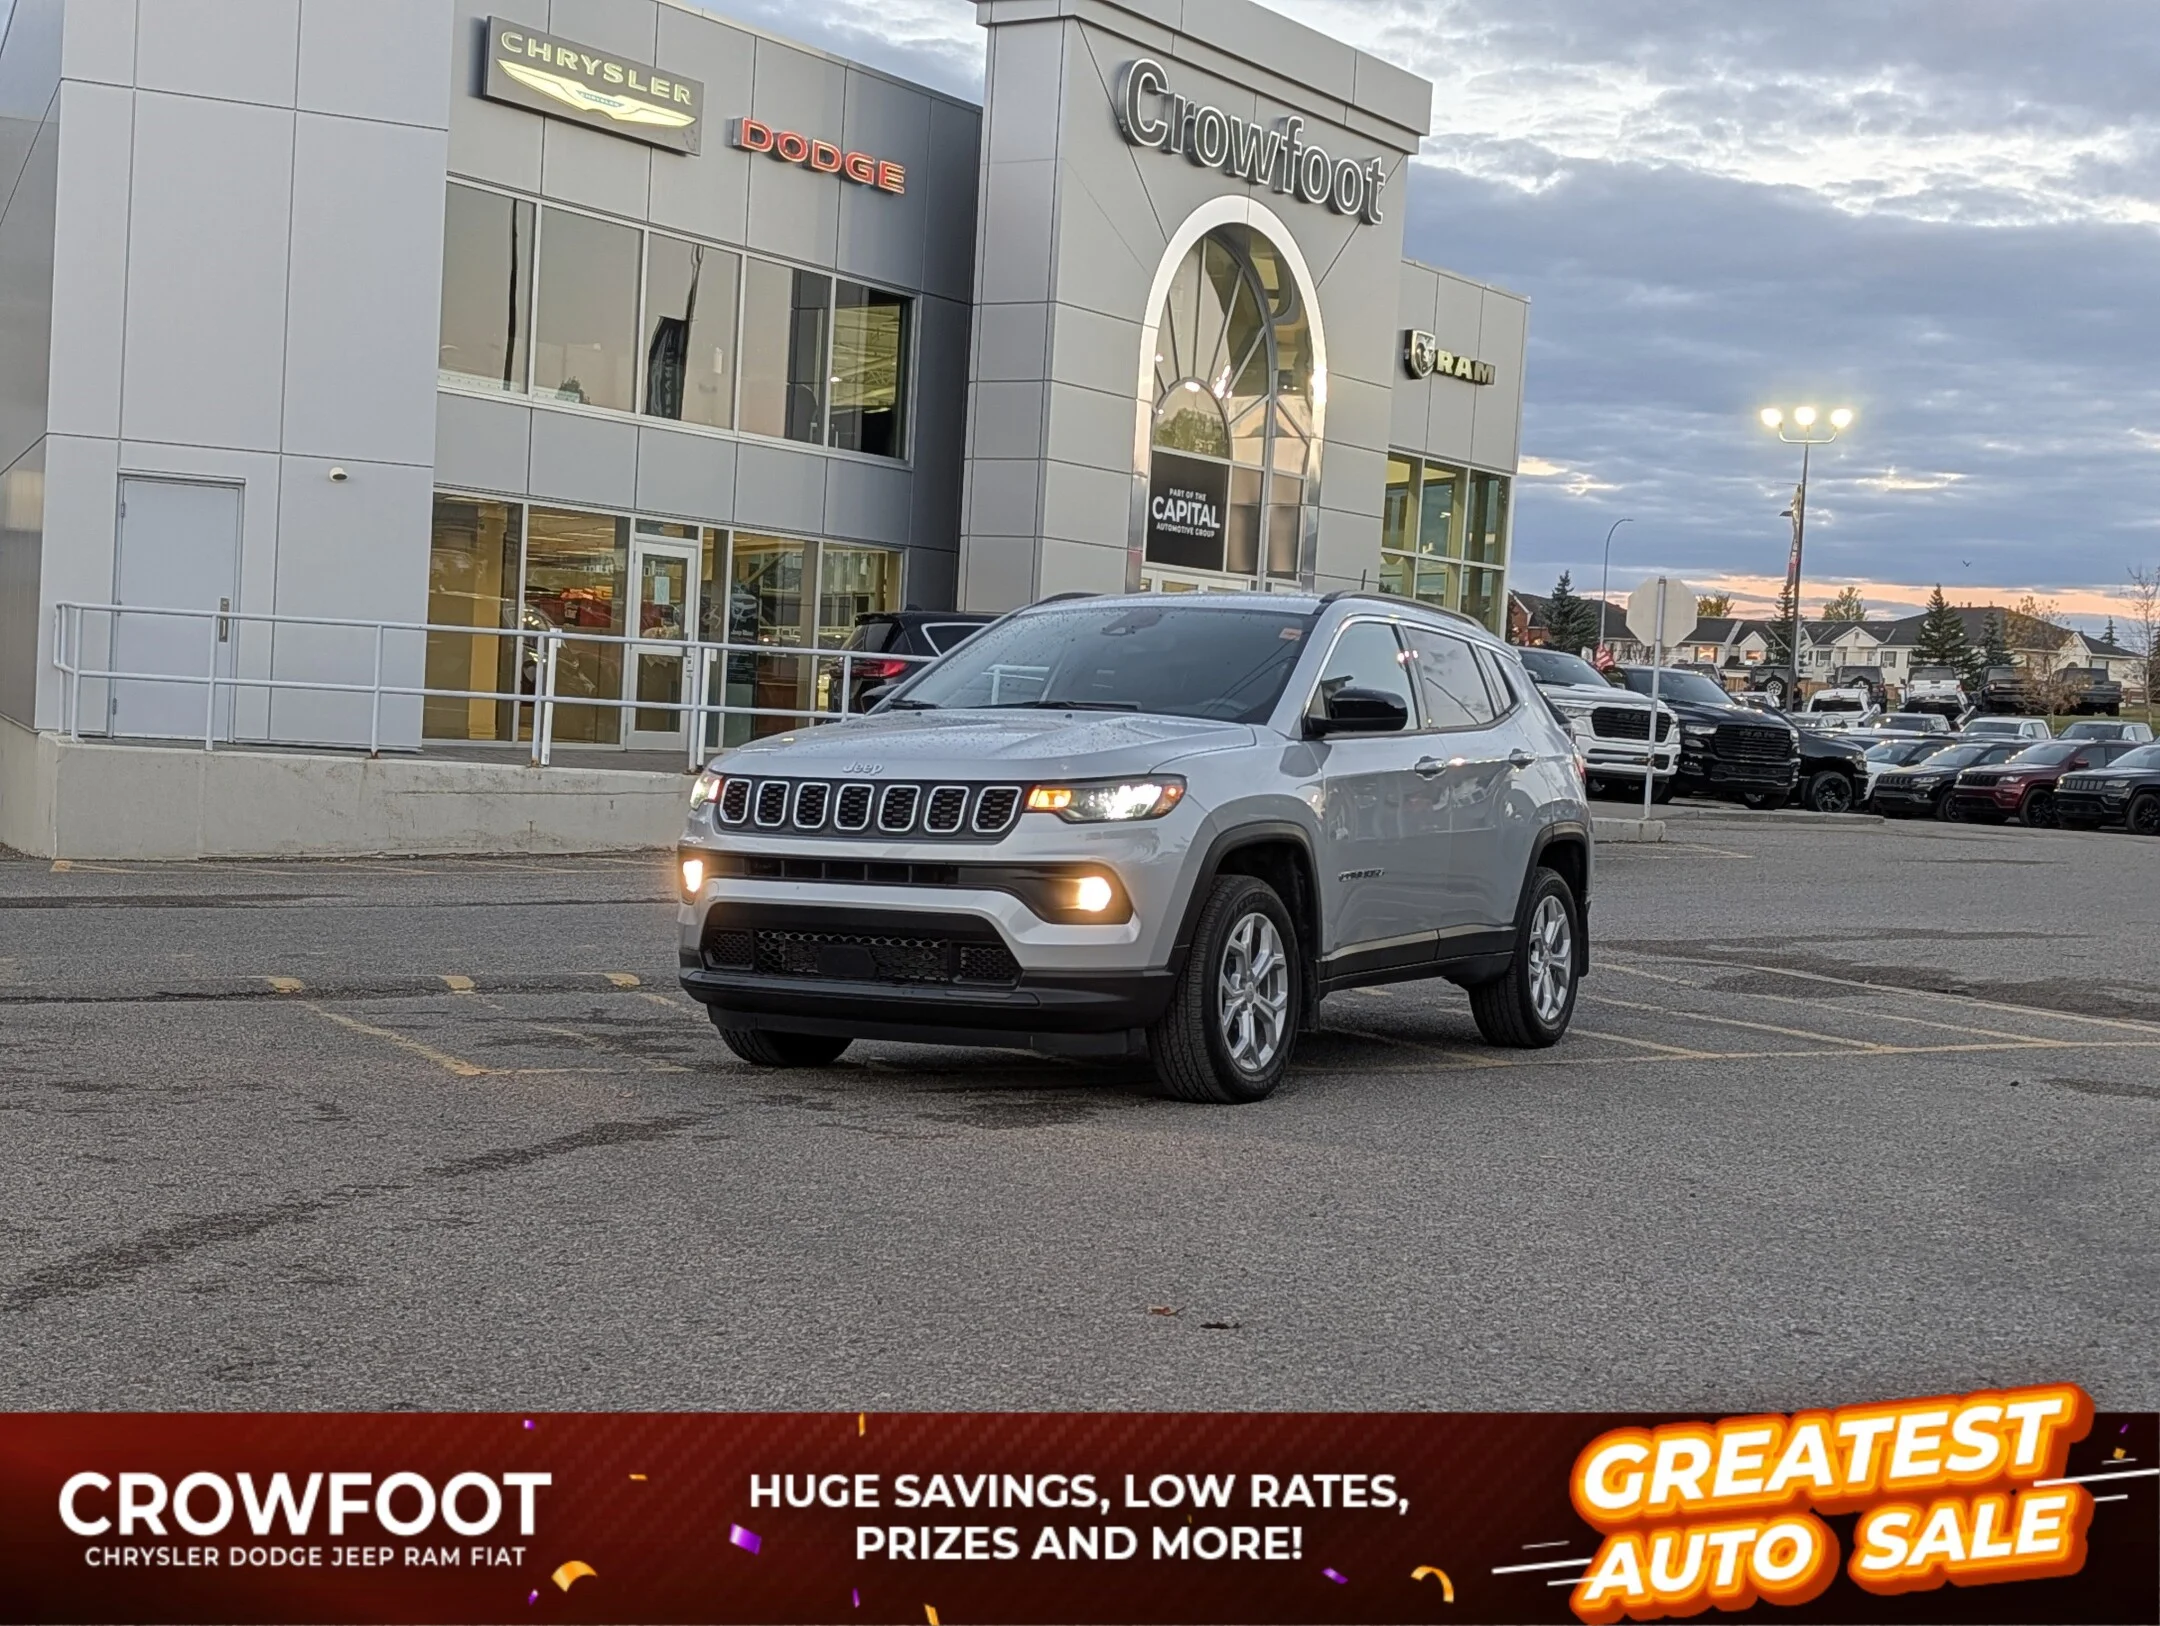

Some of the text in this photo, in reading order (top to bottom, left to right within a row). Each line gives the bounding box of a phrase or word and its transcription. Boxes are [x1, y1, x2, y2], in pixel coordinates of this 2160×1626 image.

[500, 31, 692, 106] CHRYSLER
[740, 117, 906, 194] DODGE
[1121, 58, 1386, 225] Crowfoot
[1437, 348, 1496, 386] RAM
[1152, 495, 1221, 529] CAPITAL
[1169, 487, 1207, 502] PART OF THE
[1156, 522, 1215, 538] AUTOMOTIVE GROUP
[842, 761, 884, 776] Jeep
